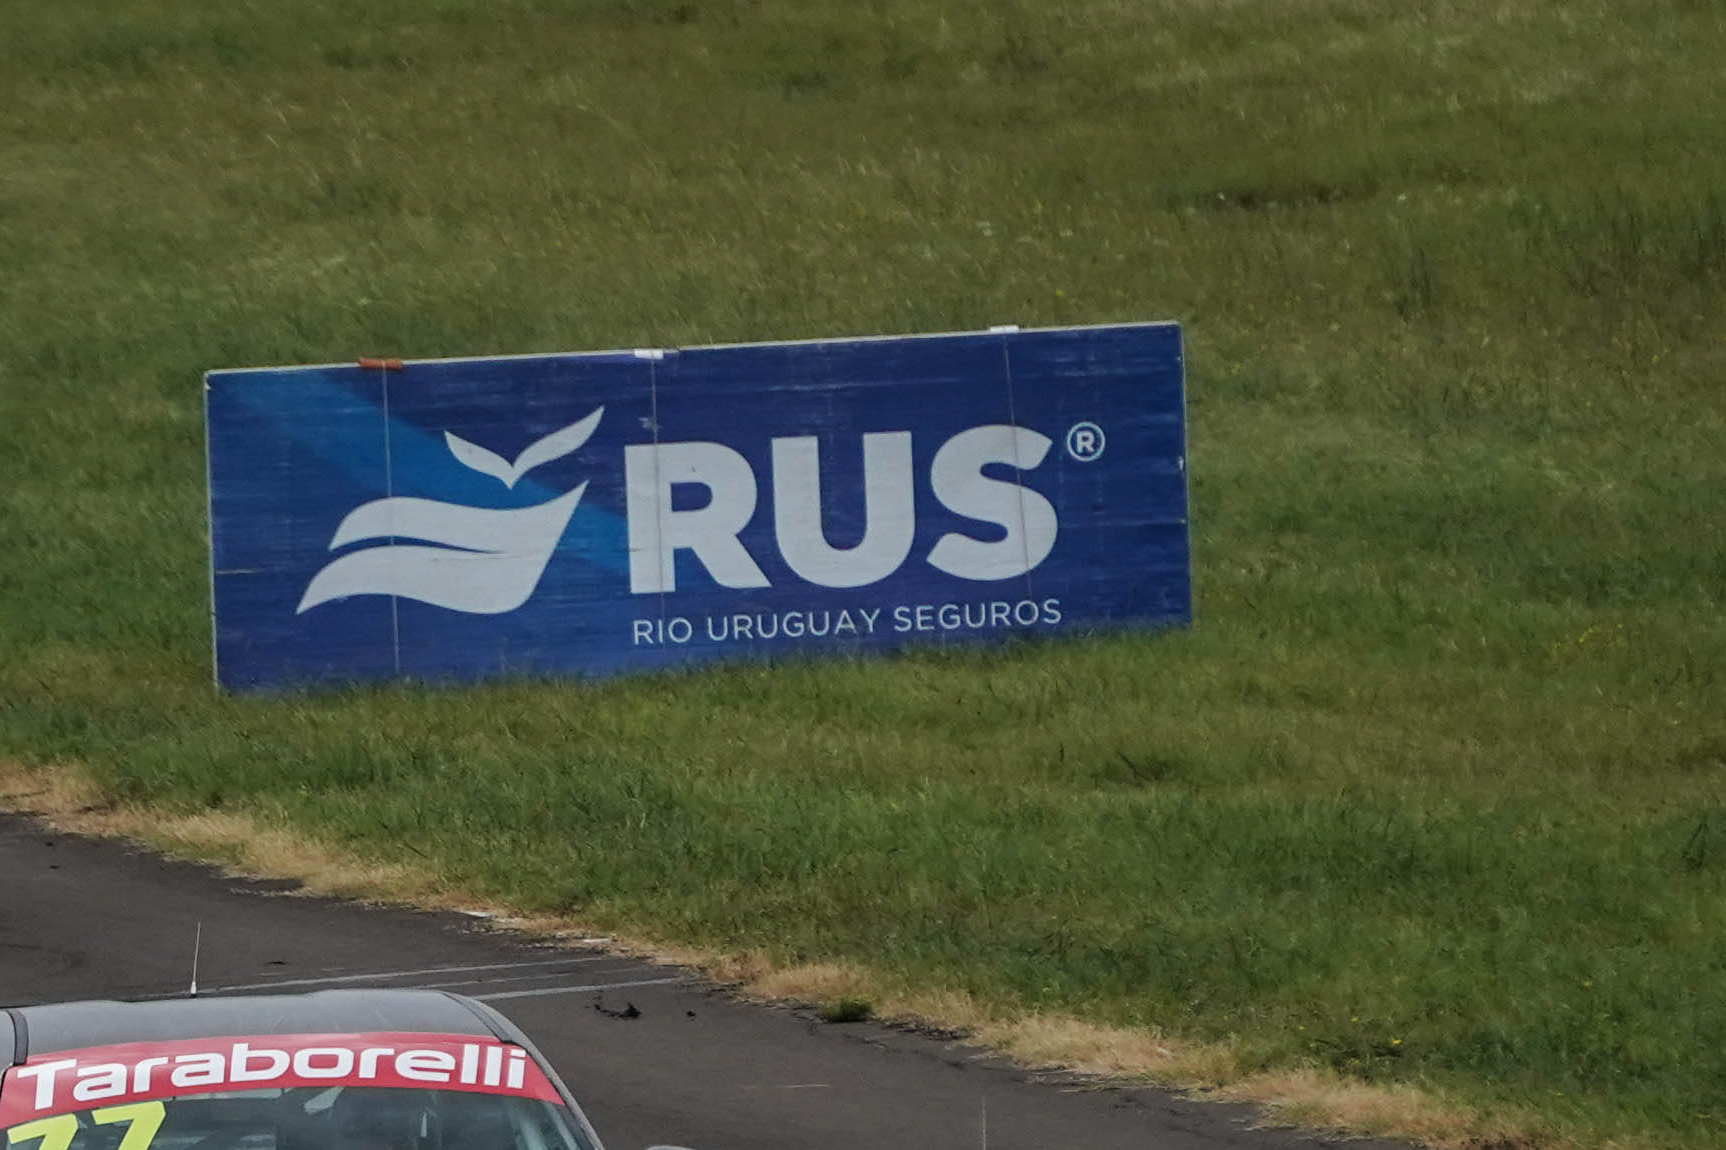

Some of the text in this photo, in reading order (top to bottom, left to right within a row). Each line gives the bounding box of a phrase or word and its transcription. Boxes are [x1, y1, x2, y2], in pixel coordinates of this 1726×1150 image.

[634, 597, 1063, 646] RIO URUGUAY SEGUROS
[14, 1042, 527, 1112] Taraborelli
